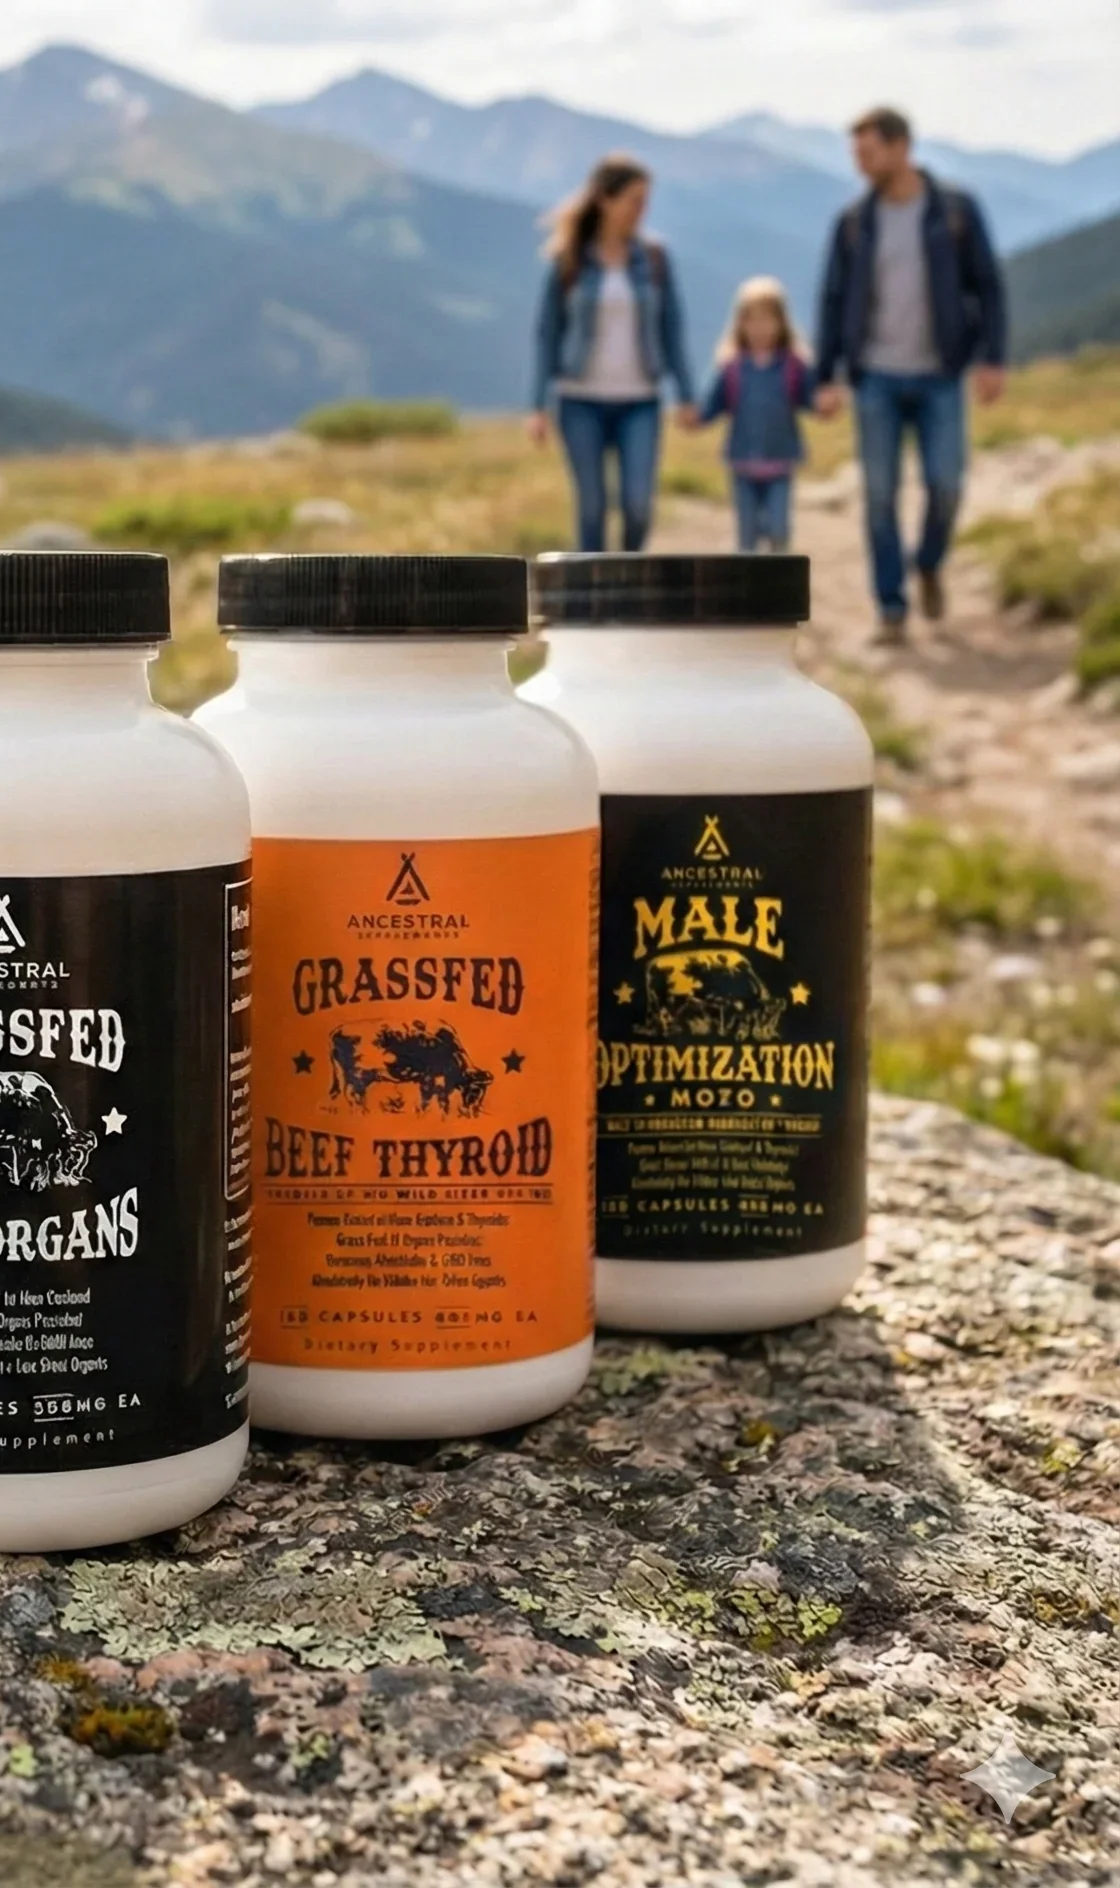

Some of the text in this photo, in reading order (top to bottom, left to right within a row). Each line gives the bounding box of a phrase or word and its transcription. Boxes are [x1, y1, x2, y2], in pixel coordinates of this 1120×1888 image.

[661, 866, 764, 881] ANCESTRAL
[347, 914, 470, 929] ANCESTRAL
[633, 896, 784, 961] MALE
[292, 956, 525, 1016] GRASSFED
[596, 1039, 835, 1090] OPTIMIZATION
[264, 1117, 553, 1178] BEEF THYROID
[637, 1199, 730, 1212] CAPSULES
[319, 1310, 422, 1323] CAPSULES
[391, 1339, 511, 1355] Supplement
[118, 1393, 141, 1409] EA
